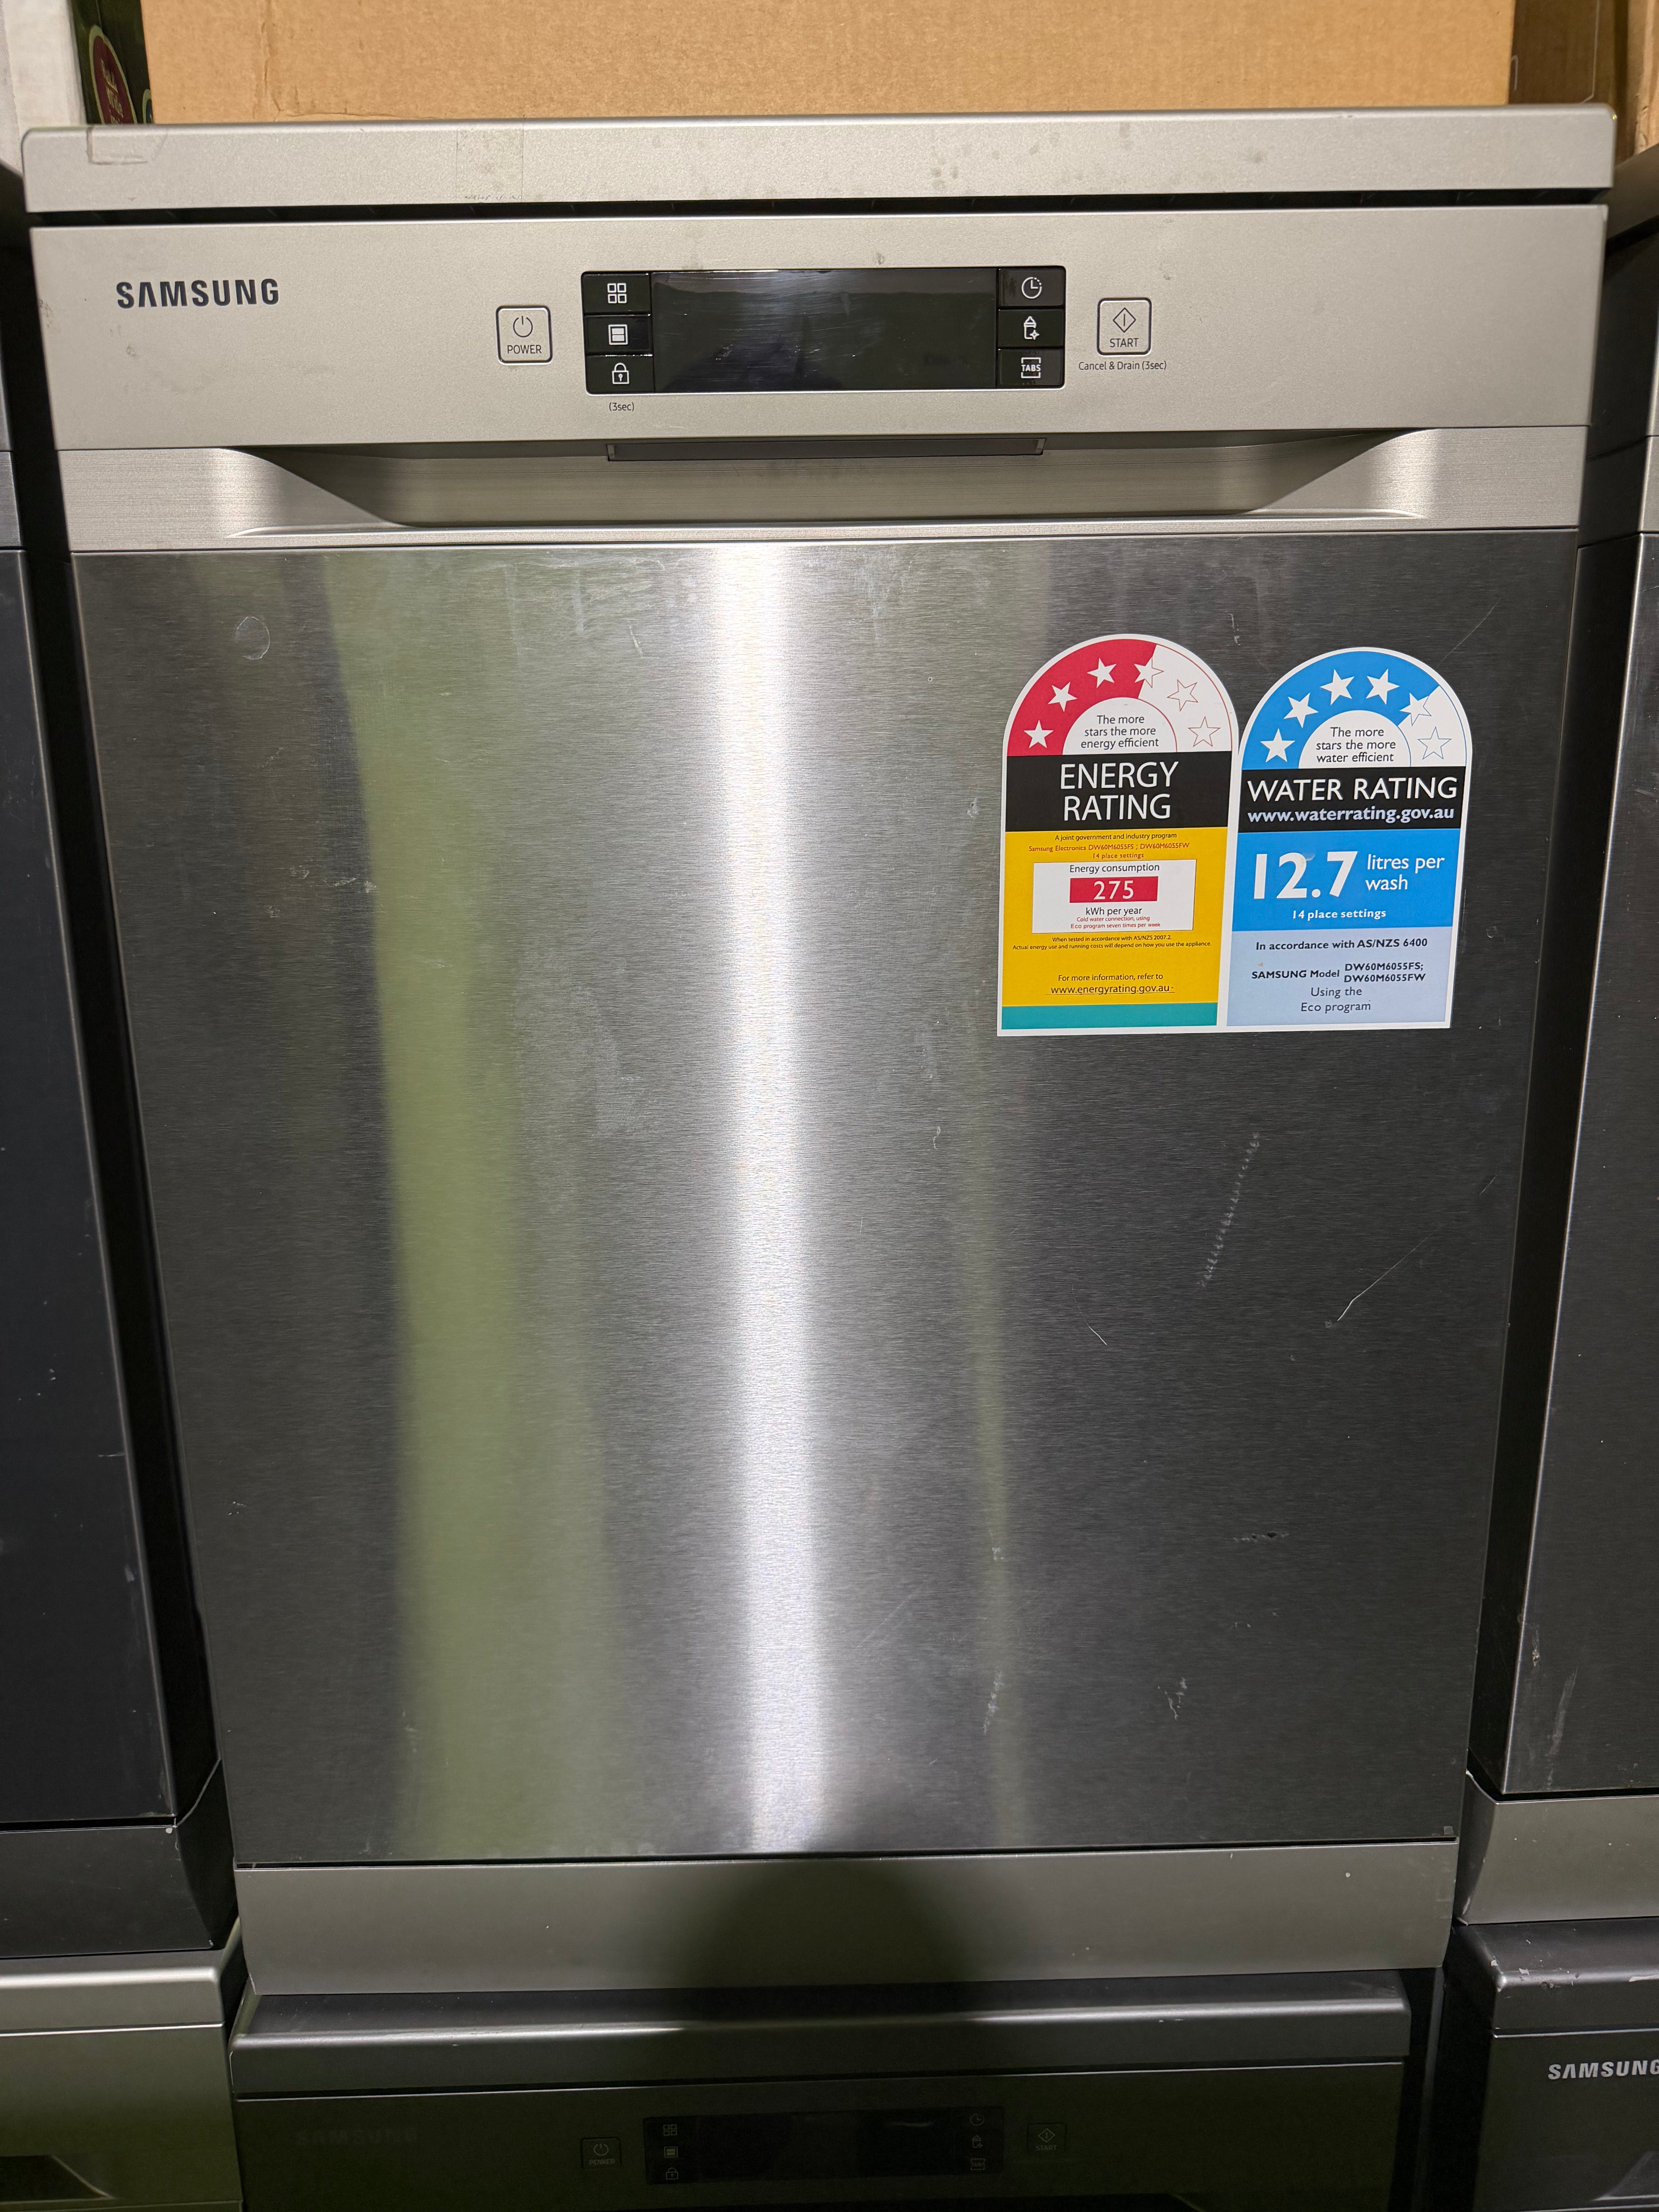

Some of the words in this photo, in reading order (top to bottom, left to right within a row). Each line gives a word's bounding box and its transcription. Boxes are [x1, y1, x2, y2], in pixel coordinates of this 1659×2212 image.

[116, 279, 278, 309] SAMSUNG
[1110, 338, 1139, 348] START
[507, 345, 542, 354] POWER
[1079, 361, 1107, 370] Cancel
[1117, 361, 1140, 370] Drain
[1142, 361, 1166, 370] (3sec)
[609, 402, 634, 411] (3sec)
[1097, 715, 1115, 724] The
[1111, 727, 1127, 736] the
[1330, 727, 1351, 737] The
[1081, 740, 1116, 750] energy
[1118, 738, 1159, 747] efficient
[1346, 740, 1363, 749] the
[1352, 752, 1394, 762] efficient
[1061, 761, 1178, 789] ENERGY
[1248, 779, 1343, 801] WATER
[1354, 777, 1457, 800] RATING
[1064, 793, 1171, 821] RATING
[1248, 806, 1454, 823] www.waterrating.gov.au
[1070, 864, 1099, 874] Energy
[1102, 863, 1160, 873] consumption
[1367, 854, 1409, 870] litres
[1415, 857, 1444, 874] per
[1254, 851, 1358, 899] 12.7
[1365, 874, 1408, 891] wash
[1094, 880, 1134, 900] 275
[1085, 907, 1104, 915] kWh
[1107, 909, 1121, 917] per
[1124, 908, 1142, 917] year
[1293, 910, 1304, 919] 14
[1307, 910, 1338, 921] place
[1341, 909, 1386, 920] settings
[1256, 942, 1265, 950] In
[1269, 941, 1329, 950] accordance
[1333, 940, 1354, 948] with
[1357, 939, 1400, 948] AS/NZS
[1403, 938, 1427, 947] 6400
[1345, 962, 1423, 971] DW60M6055FS;
[1252, 970, 1307, 979] SAMSUNG
[1310, 970, 1340, 978] Model
[1344, 973, 1426, 982] DW60M6055FW
[1051, 985, 1169, 994] www.energyrating.gov.au
[1311, 988, 1341, 999] Using
[1345, 987, 1362, 996] the
[1301, 1003, 1321, 1012] Eco
[1325, 1003, 1371, 1014] program
[1548, 2059, 1659, 2080] SAMSUNG
